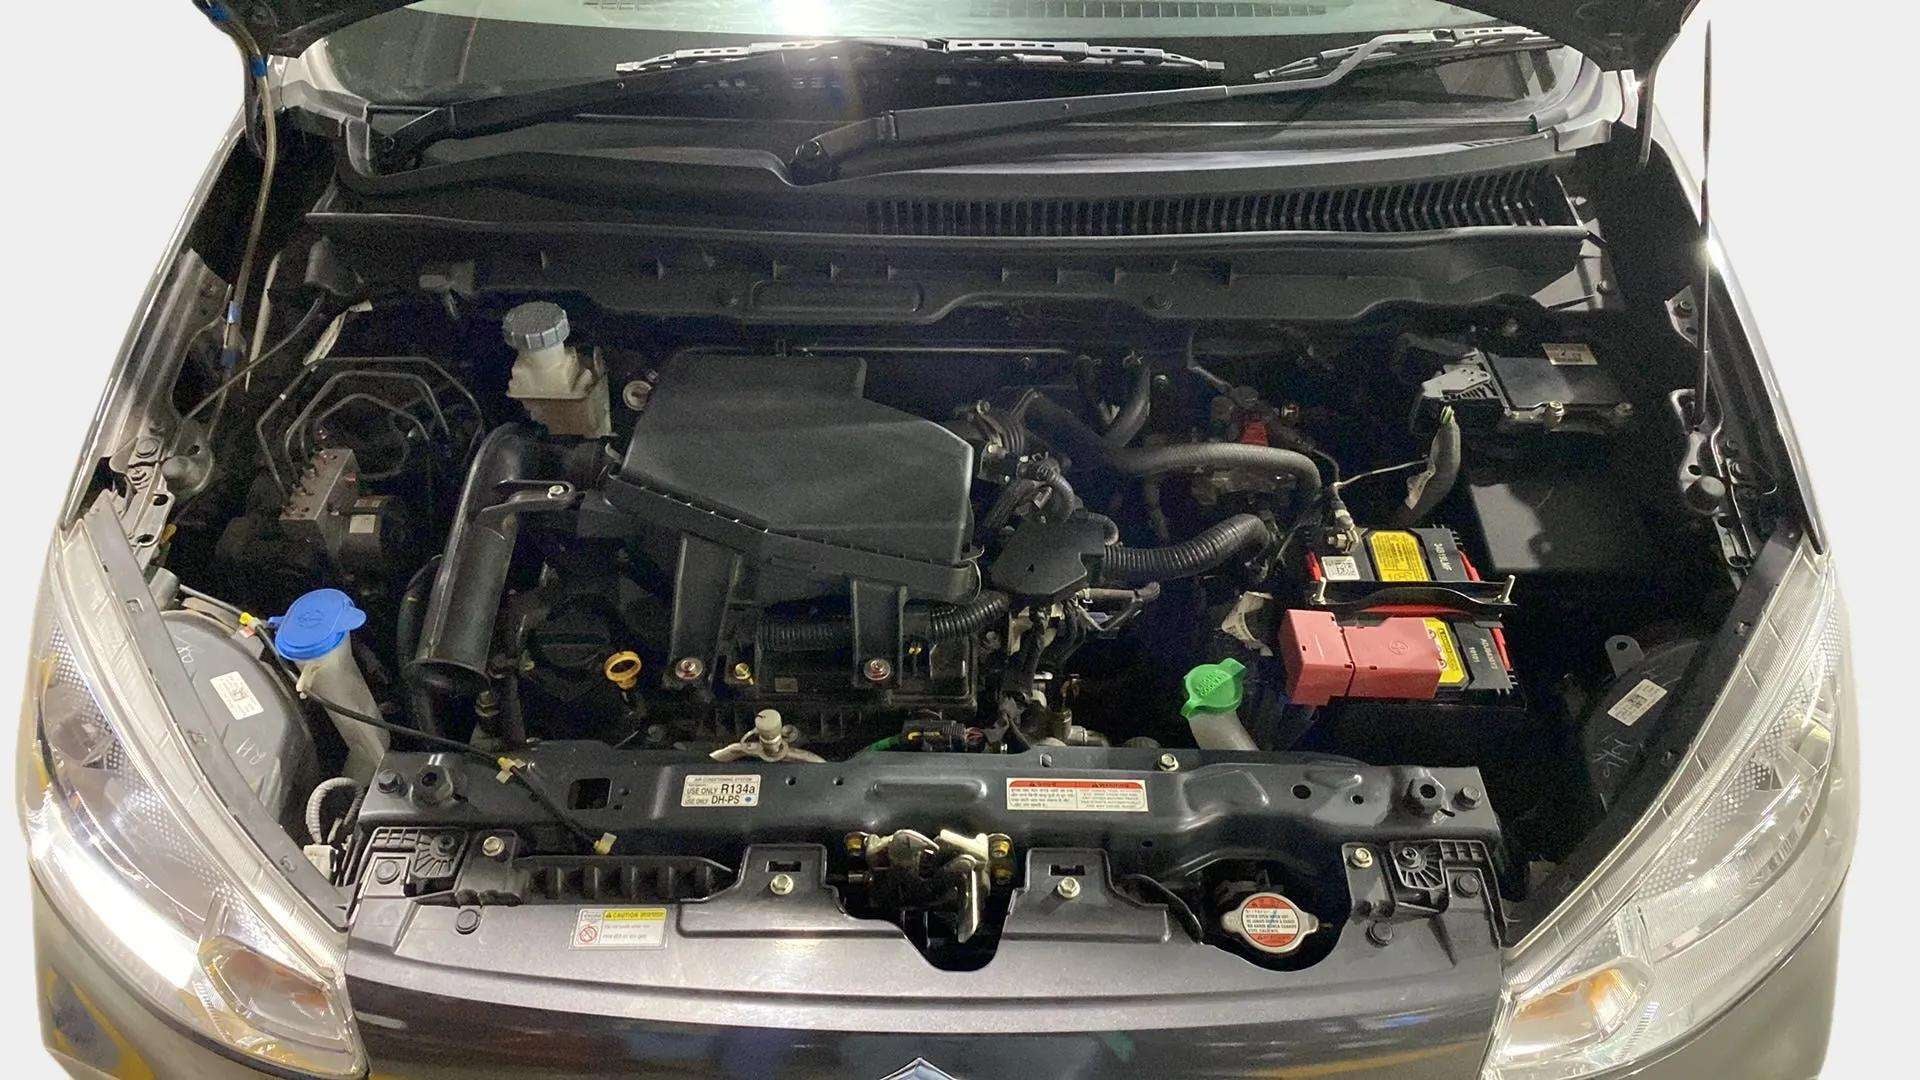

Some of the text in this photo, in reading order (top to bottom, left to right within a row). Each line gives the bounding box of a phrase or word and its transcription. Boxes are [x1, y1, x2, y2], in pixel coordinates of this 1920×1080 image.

[720, 783, 756, 794] R134a
[711, 794, 740, 804] DH-PS
[612, 911, 638, 919] CAUTION
